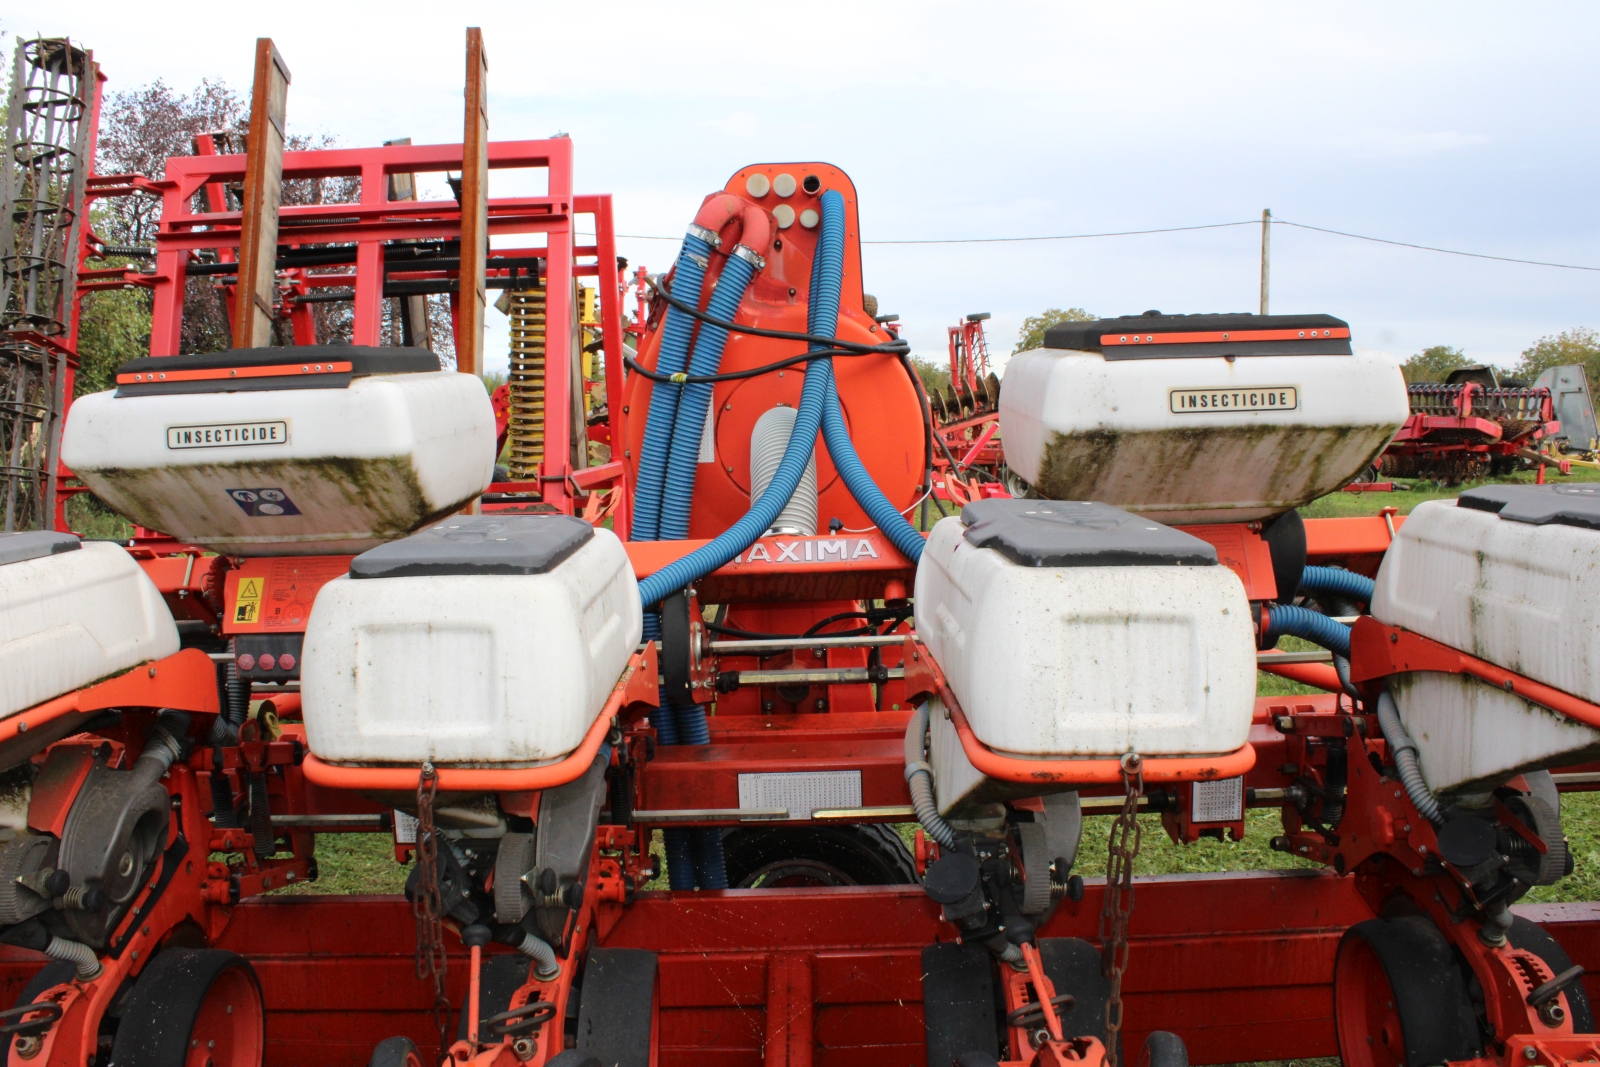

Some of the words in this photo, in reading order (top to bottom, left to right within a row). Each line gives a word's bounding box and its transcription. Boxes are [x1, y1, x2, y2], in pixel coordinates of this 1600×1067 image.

[1181, 392, 1287, 408] INSECTICIDE
[176, 426, 277, 444] INSECTICIDE
[733, 539, 878, 563] AXIMA
